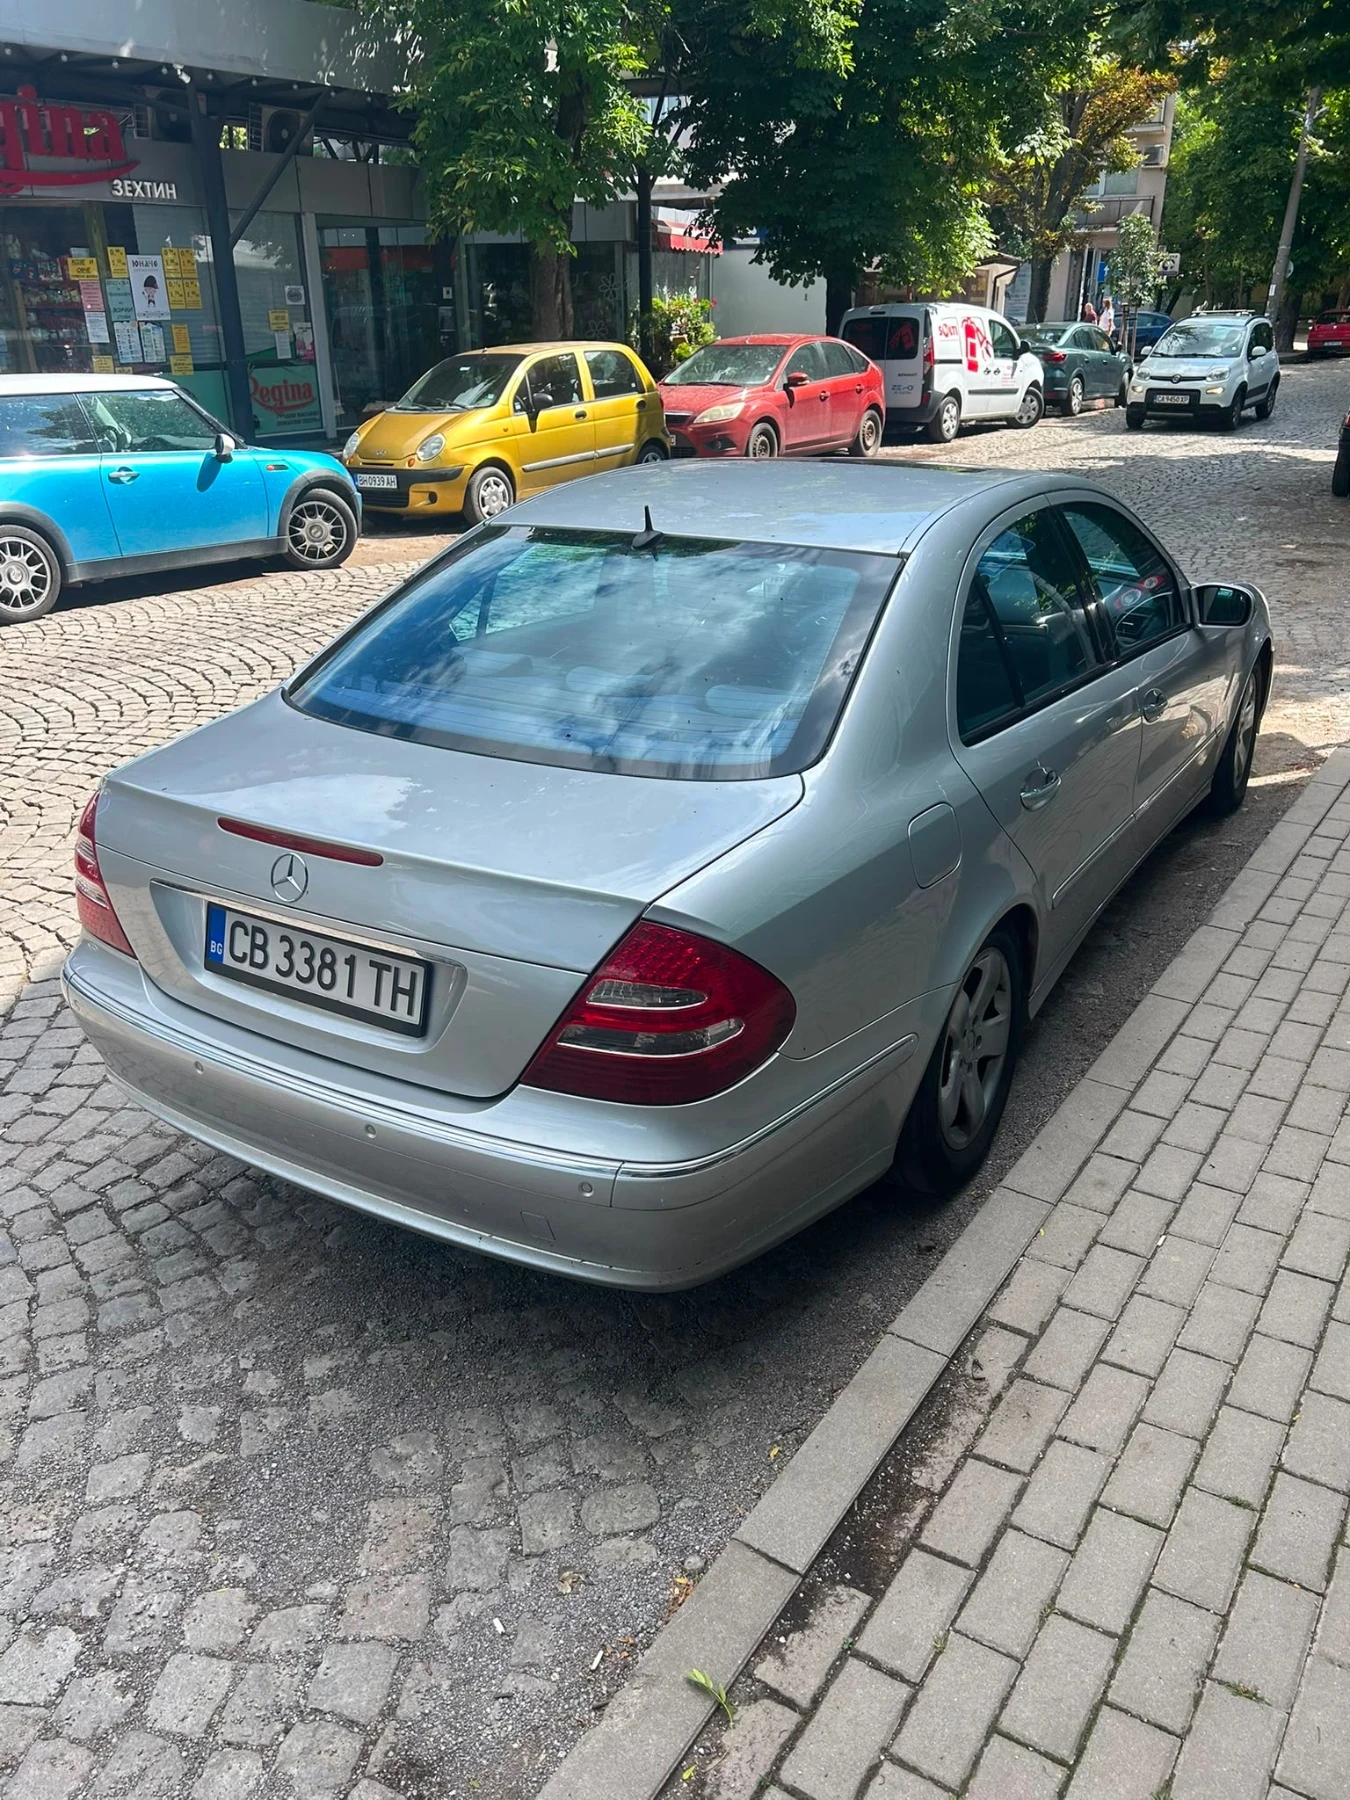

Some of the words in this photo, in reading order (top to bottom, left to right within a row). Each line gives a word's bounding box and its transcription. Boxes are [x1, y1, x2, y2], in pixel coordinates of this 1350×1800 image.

[112, 179, 177, 199] ЗЕХТИН
[210, 940, 223, 955] BG
[275, 935, 357, 998] 3381
[369, 960, 418, 1017] TH
